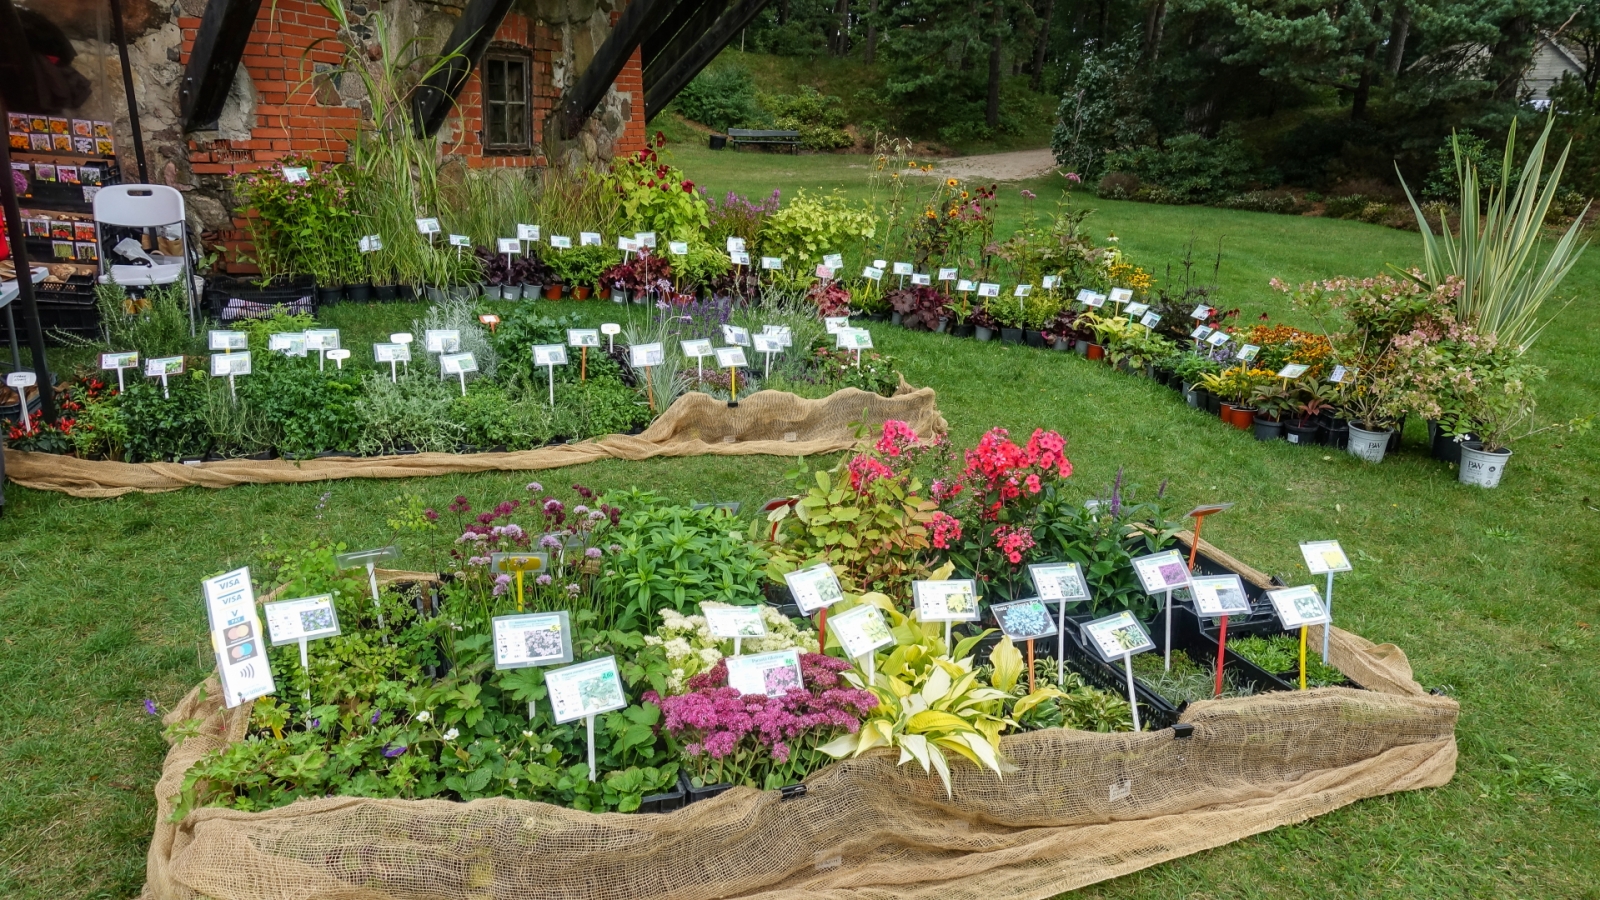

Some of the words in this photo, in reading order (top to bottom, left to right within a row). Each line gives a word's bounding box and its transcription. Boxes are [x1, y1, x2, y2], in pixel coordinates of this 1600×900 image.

[219, 578, 240, 590] VISA
[222, 594, 242, 605] VISA
[231, 609, 238, 617] V
